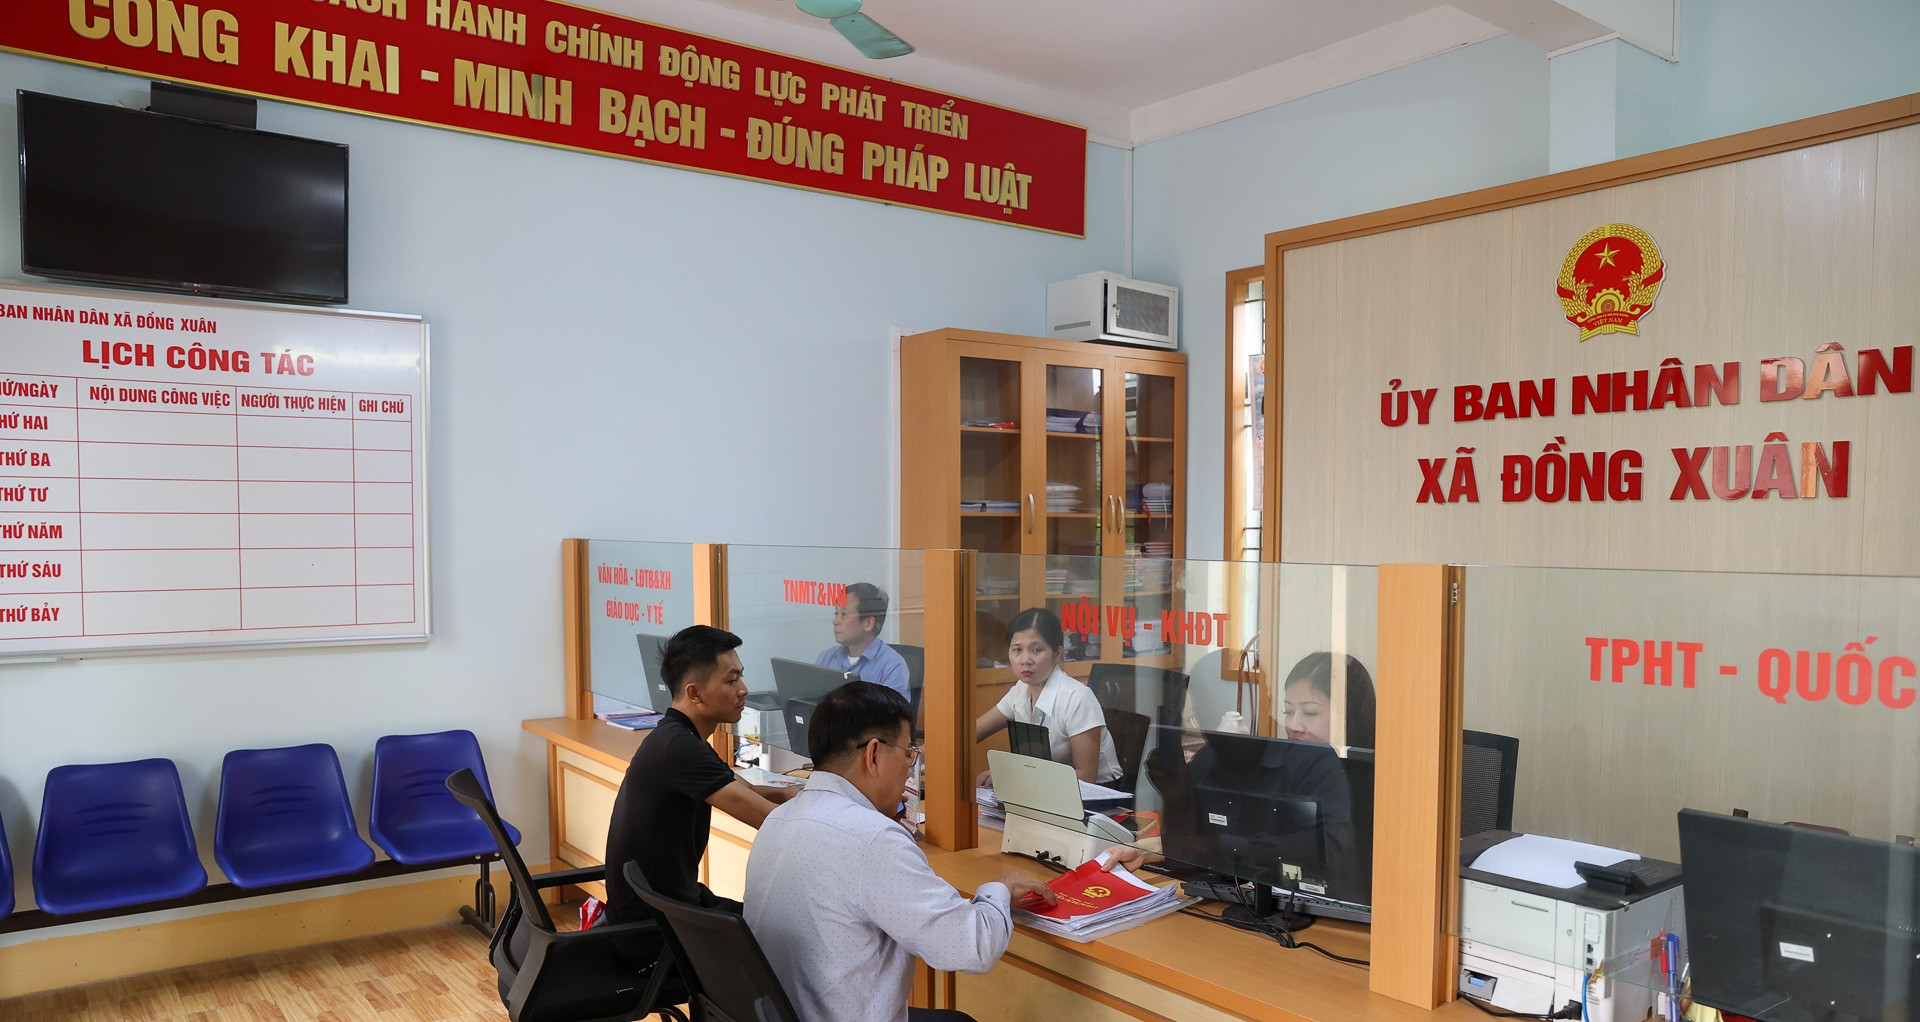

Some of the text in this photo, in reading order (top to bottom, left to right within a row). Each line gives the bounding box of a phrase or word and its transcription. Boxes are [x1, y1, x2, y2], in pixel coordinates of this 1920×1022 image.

[545, 20, 644, 71] CHÍNH
[658, 44, 741, 91] ĐỘNG
[755, 67, 807, 106] LỰC
[821, 82, 887, 122] PHÁT
[900, 100, 969, 141] TRIỂN
[273, 22, 400, 95] KHAI
[421, 70, 438, 81] -
[453, 58, 573, 126] MINH
[599, 87, 706, 151] BẠCH
[721, 128, 735, 138] -
[746, 116, 845, 176] ĐÚNG
[862, 141, 949, 193] PHÁP
[963, 162, 1032, 215] LUẬT
[33, 306, 75, 323] NHÂN
[80, 309, 109, 325] DÂN
[114, 311, 133, 328] XÃ
[136, 311, 175, 331] ĐỒNG
[181, 318, 216, 333] XUÂN
[83, 340, 314, 376] LỊCH CÔNG TÁC
[0, 378, 58, 398] Ứ/NGÀY
[1381, 342, 1914, 427] ỦY BAN NHÂN DÂN
[89, 385, 231, 408] NỘI DUNG CÔNG VIỆC
[241, 392, 346, 413] NGƯỜI THỰC HIỆN
[359, 400, 404, 414] GHI CHÚ
[0, 411, 48, 430] HỨ HAI
[30, 452, 51, 466] BA
[1416, 431, 1851, 504] XÃ ĐỒNG XUÂN
[29, 487, 48, 502] TƯ
[0, 521, 63, 539] HỨ NĂM
[32, 561, 62, 578] SÁU
[31, 602, 60, 622] BẢY
[646, 604, 652, 623] Y
[1062, 596, 1098, 641] NỘI
[1106, 606, 1135, 646] VỤ
[1162, 610, 1227, 646] KHĐT
[1585, 636, 1917, 709] TPHT - QUỐC
